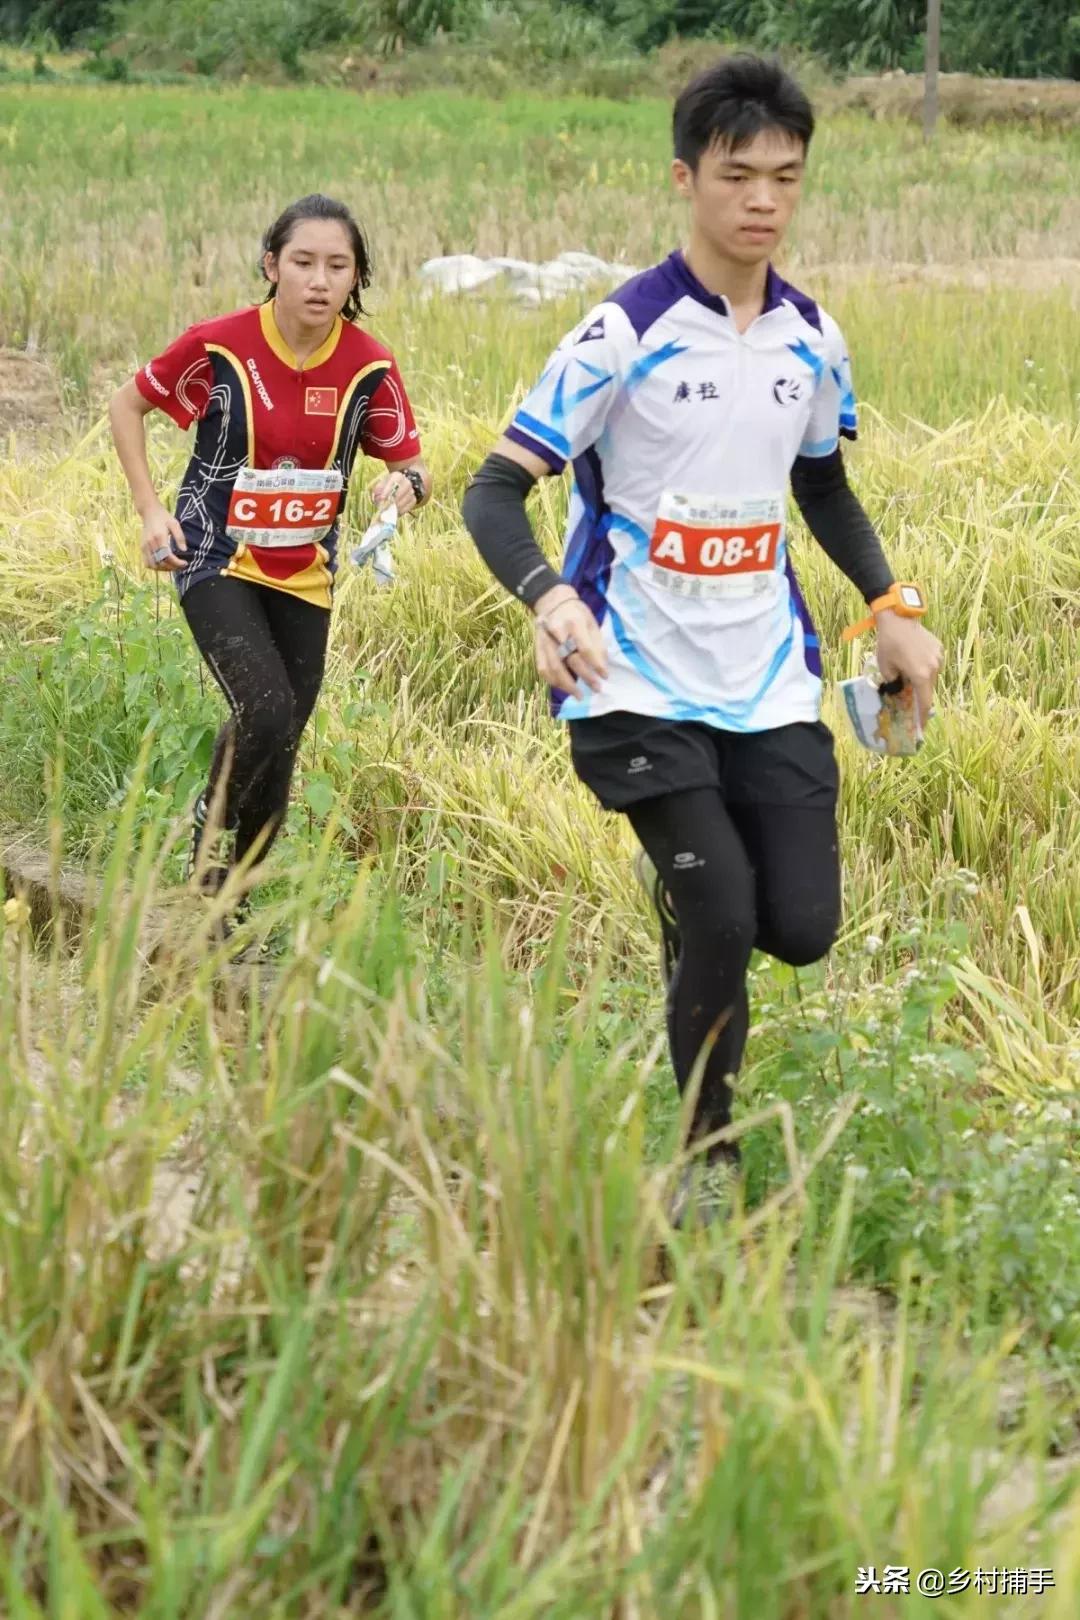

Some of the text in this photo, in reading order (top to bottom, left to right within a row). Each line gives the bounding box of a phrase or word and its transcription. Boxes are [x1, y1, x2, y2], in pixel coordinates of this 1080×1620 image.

[234, 498, 332, 522] C 16-2
[653, 531, 771, 568] A 08-1
